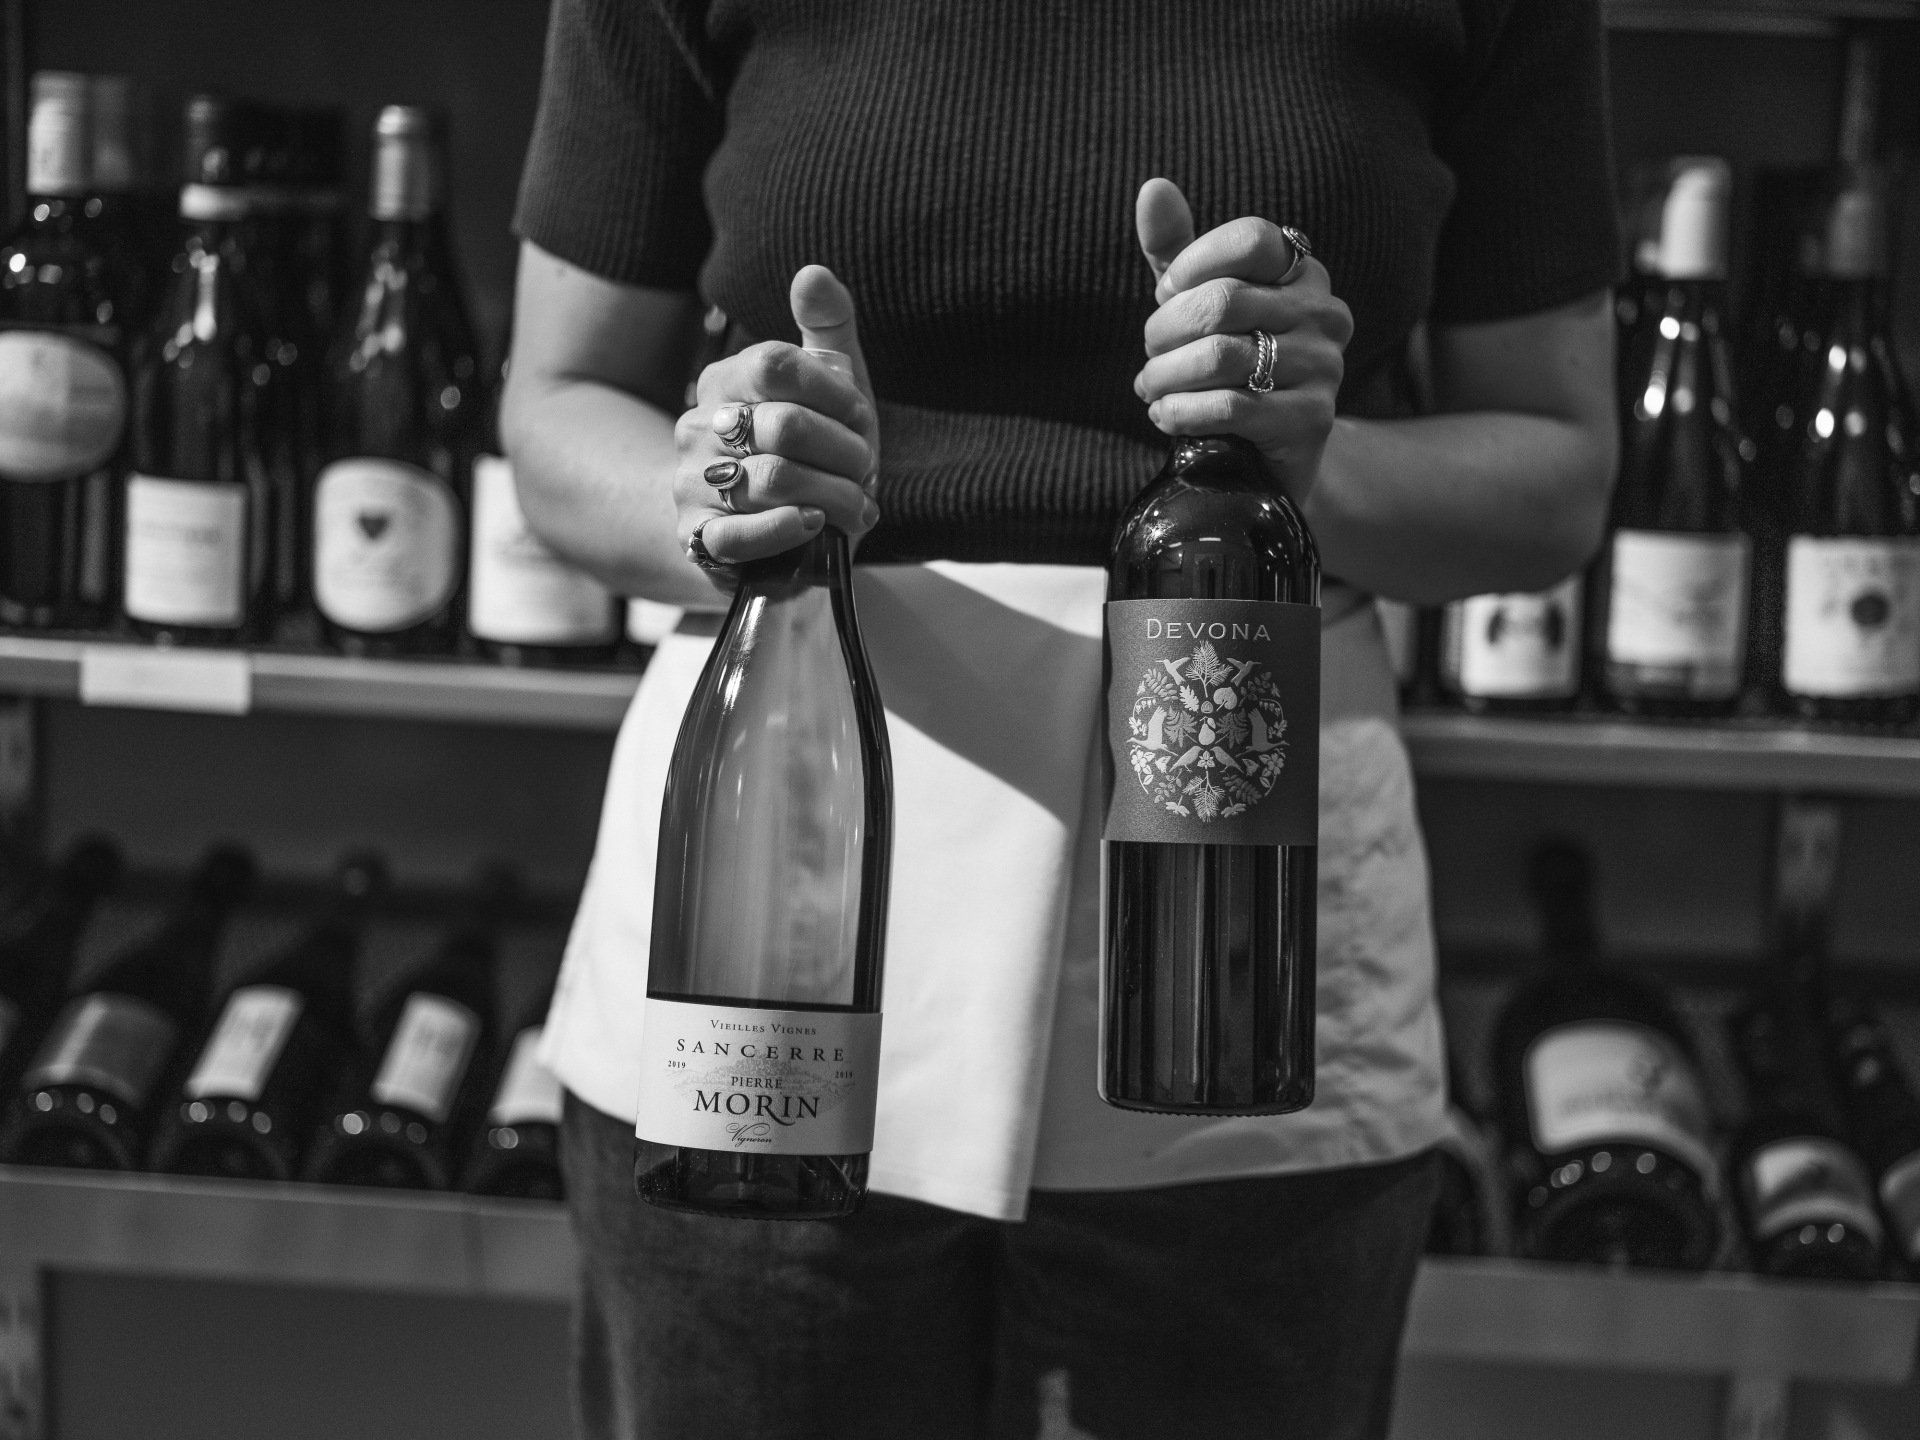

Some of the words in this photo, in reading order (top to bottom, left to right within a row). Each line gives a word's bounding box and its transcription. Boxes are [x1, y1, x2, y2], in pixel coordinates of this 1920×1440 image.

[1147, 618, 1271, 641] DEVONA
[710, 1019, 765, 1033] VIEILLES
[771, 1023, 817, 1036] VIGNES
[677, 1038, 845, 1062] SANCERRE
[667, 1060, 686, 1069] 2019
[731, 1076, 783, 1089] PIERRE
[835, 1071, 853, 1079] 2019
[693, 1089, 820, 1126] MORIN
[725, 1122, 772, 1148] Vigneron
